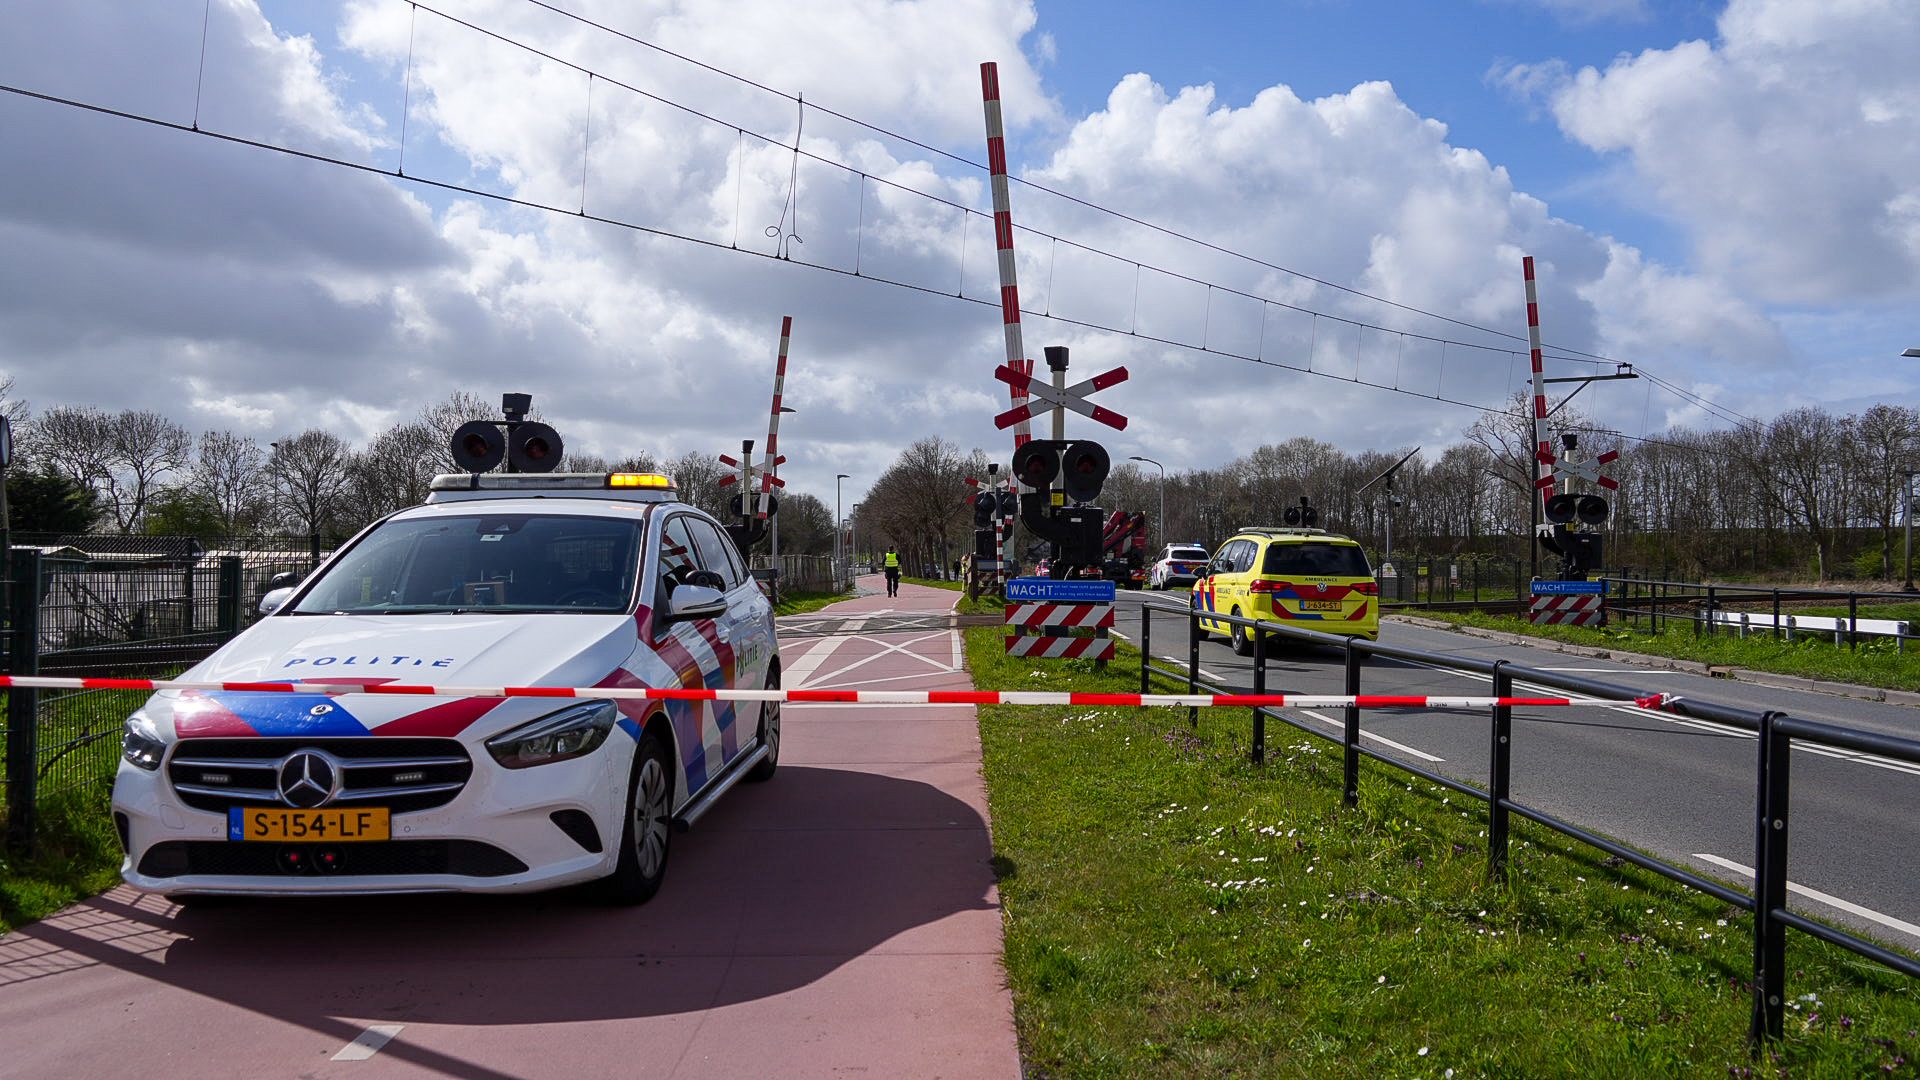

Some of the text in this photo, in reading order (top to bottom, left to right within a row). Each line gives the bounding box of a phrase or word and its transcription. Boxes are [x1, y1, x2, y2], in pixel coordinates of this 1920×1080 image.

[1010, 585, 1053, 596] WACHT
[283, 656, 454, 668] POLITIE
[254, 813, 372, 837] S-154-LF
[231, 827, 242, 835] NL
